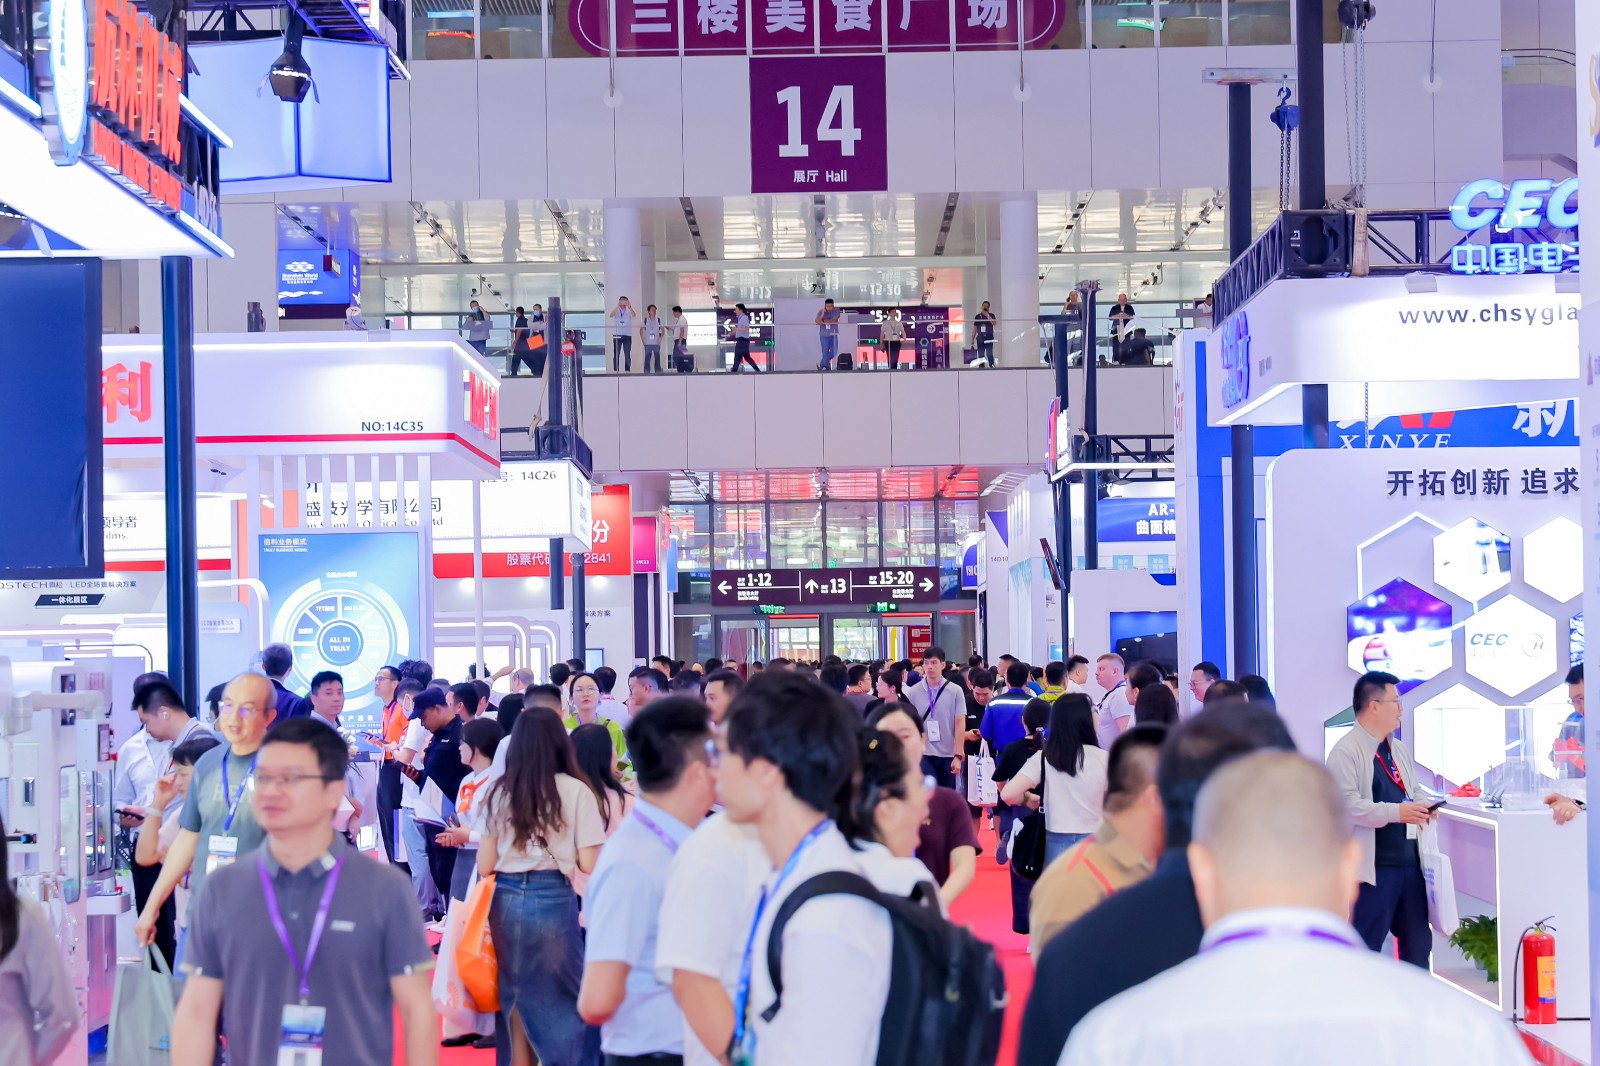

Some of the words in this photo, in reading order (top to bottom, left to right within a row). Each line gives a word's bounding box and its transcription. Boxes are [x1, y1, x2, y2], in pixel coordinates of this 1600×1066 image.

[776, 84, 862, 157] 14
[793, 170, 819, 183] 展厅
[825, 169, 848, 183] Hall
[1450, 177, 1579, 232] CEC
[361, 421, 424, 432] NO:14C35
[521, 471, 557, 481] 14C26
[1387, 469, 1510, 496] 开拓创新
[1521, 467, 1580, 495] 追求
[747, 573, 773, 586] 1-12
[879, 571, 914, 585] 15-20
[830, 578, 847, 594] 13
[1470, 633, 1508, 646] CEC
